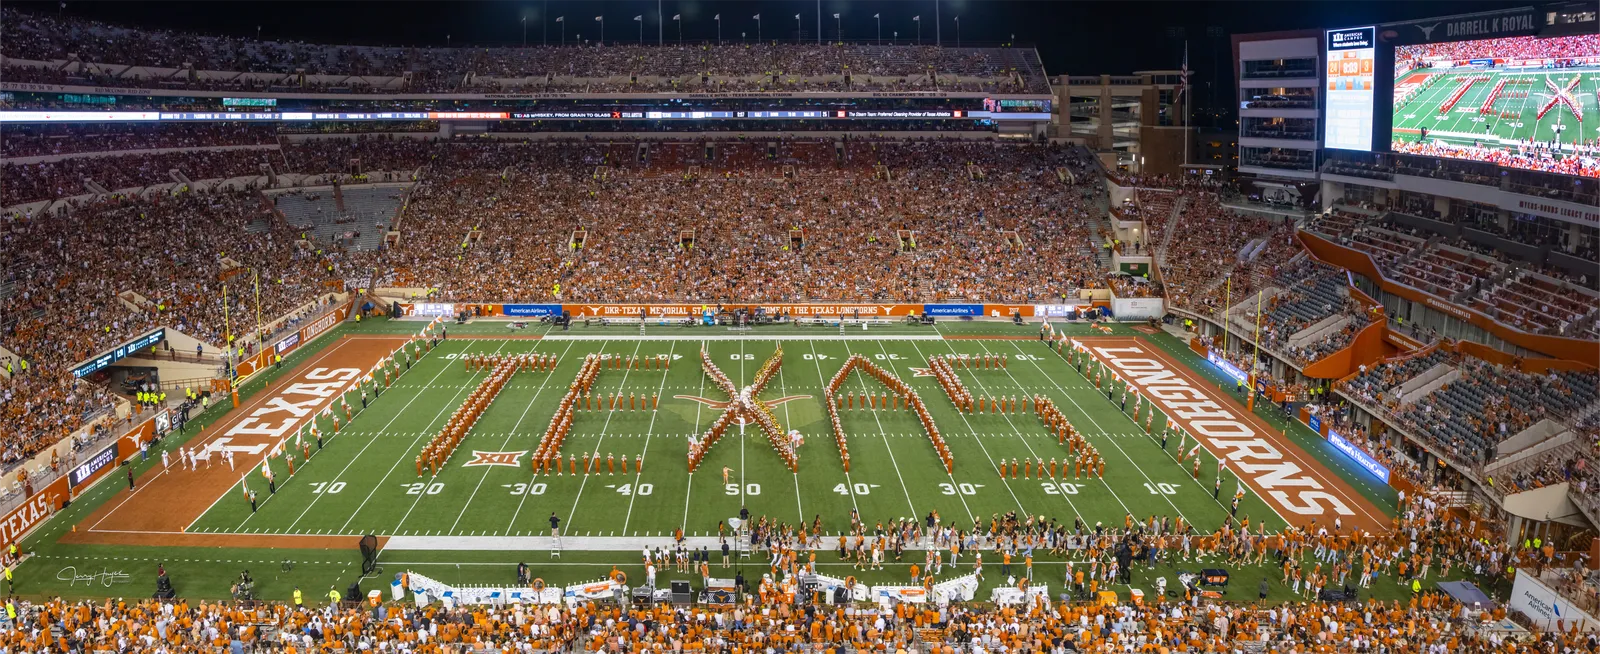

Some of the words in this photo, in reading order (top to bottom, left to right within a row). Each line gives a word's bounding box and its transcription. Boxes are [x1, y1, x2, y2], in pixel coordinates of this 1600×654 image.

[1447, 19, 1489, 36] DARRELL
[1492, 18, 1499, 32] K
[1502, 14, 1535, 32] ROYAL
[1560, 207, 1582, 219] LEGACY
[1585, 212, 1600, 222] CLUB
[810, 306, 834, 314] TEXAS
[303, 312, 336, 342] LONGHORNS
[196, 367, 362, 462] TEXAS
[416, 343, 1105, 480] TEXAS
[1093, 346, 1356, 516] LONGHORNS
[91, 449, 113, 467] AMERICAN
[91, 454, 113, 472] CAMPUS
[312, 482, 347, 494] 10
[406, 483, 445, 495] 20
[510, 483, 547, 495] 30
[616, 483, 654, 496] 40
[725, 483, 761, 496] 50
[833, 483, 871, 495] 40
[938, 483, 977, 495] 30
[1041, 482, 1079, 495] 20
[1143, 482, 1177, 495] 10
[0, 493, 47, 545] TEXAS
[1524, 590, 1553, 613] American
[1528, 600, 1551, 619] Airlines
